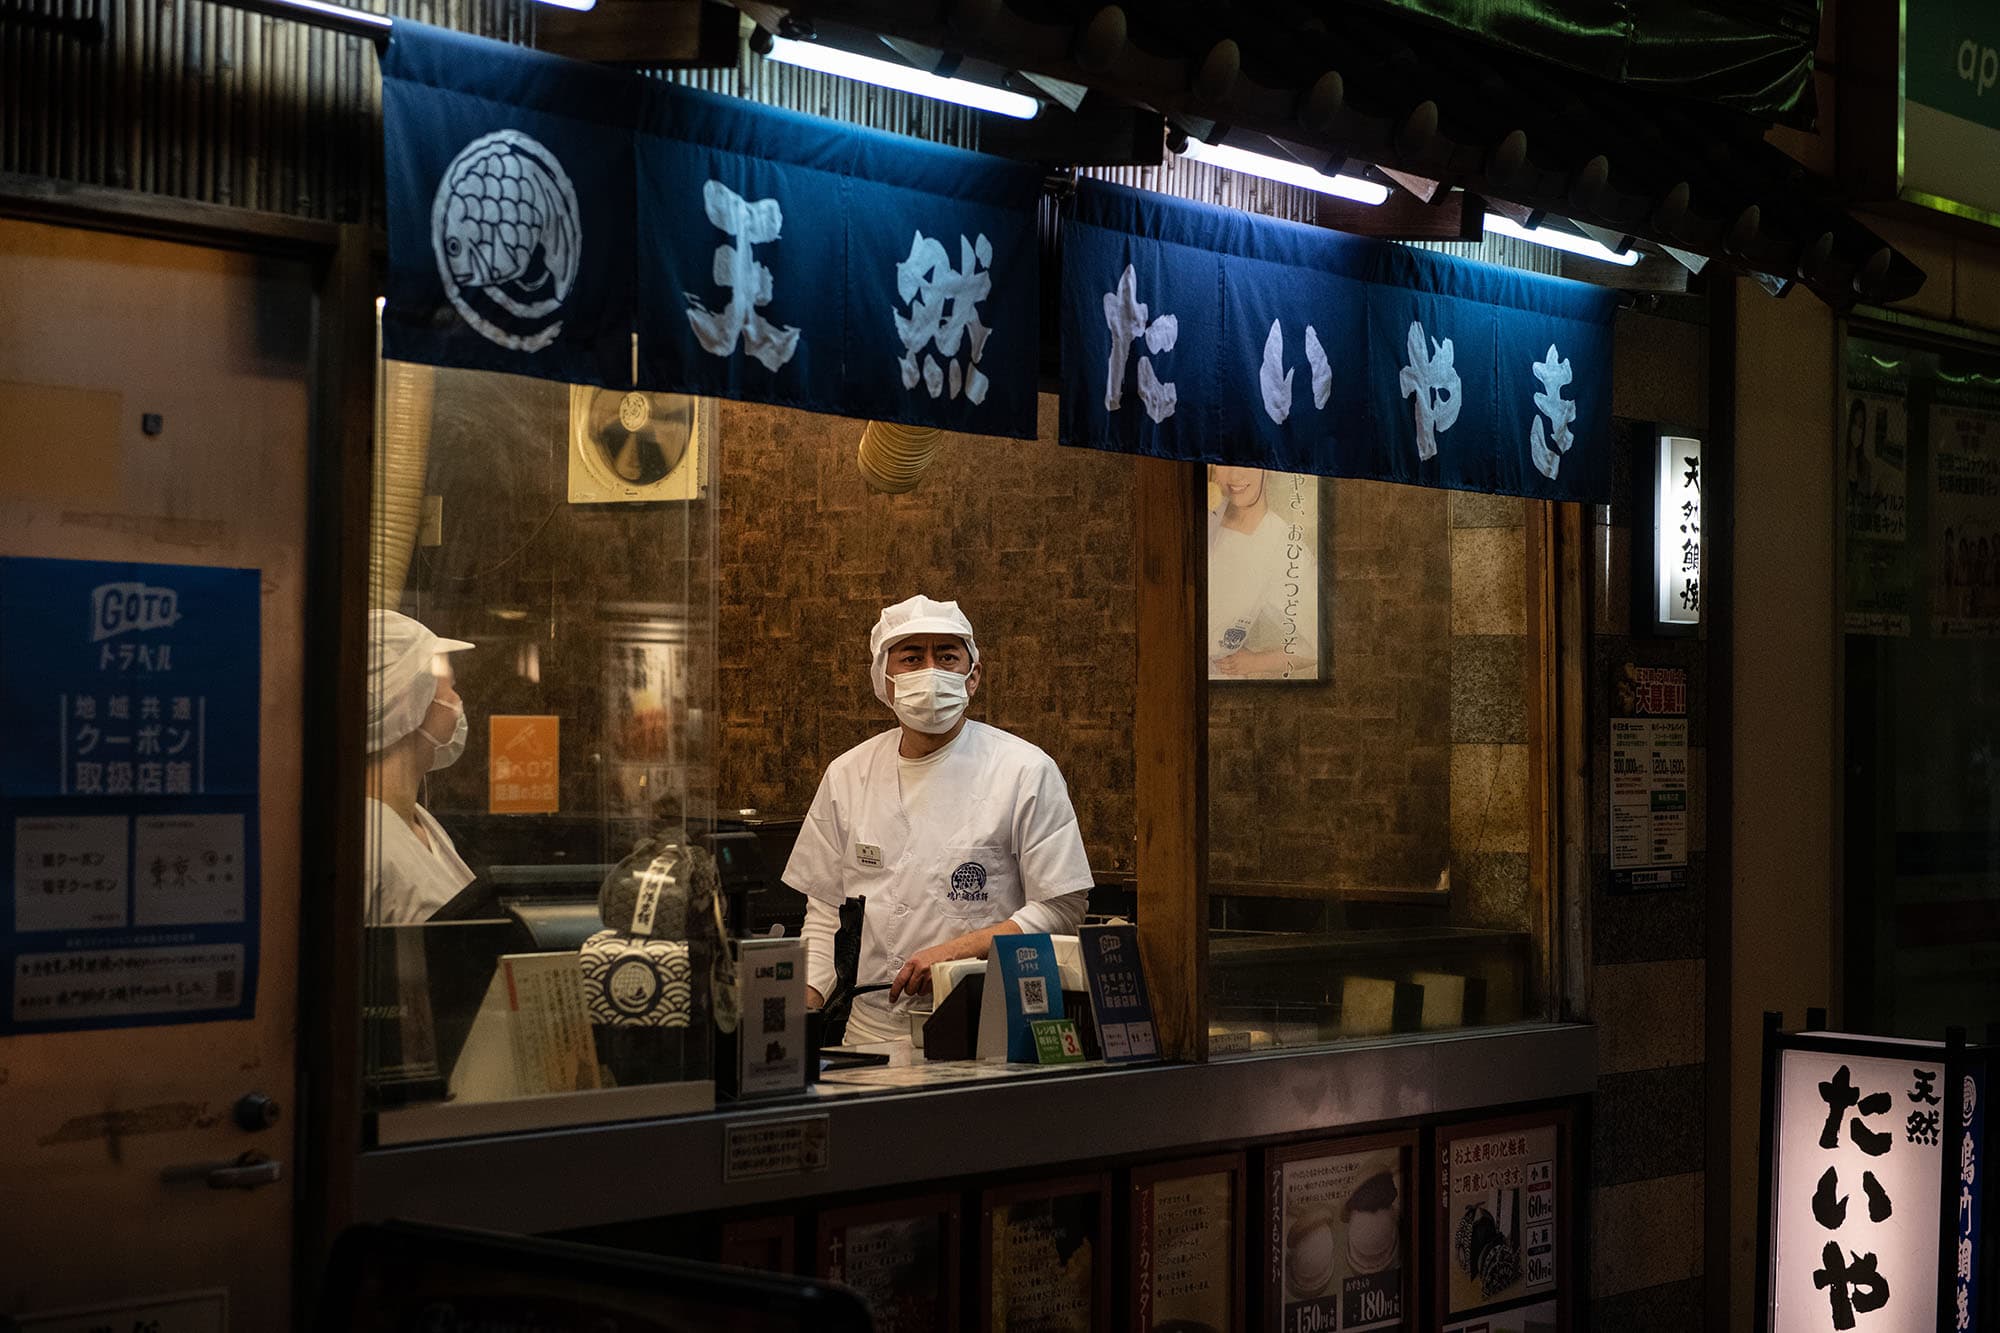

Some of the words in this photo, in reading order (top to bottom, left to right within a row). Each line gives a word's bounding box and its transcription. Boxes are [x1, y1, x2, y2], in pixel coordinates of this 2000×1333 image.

[681, 178, 994, 406] 天然
[1104, 264, 1576, 481] たいやき
[99, 643, 173, 672] トラベル
[75, 695, 192, 720] 地域共通
[76, 724, 190, 755] クーポン
[76, 761, 192, 794] 取扱店舗
[1907, 1069, 1941, 1146] 天然
[1812, 1065, 1893, 1331] たいや
